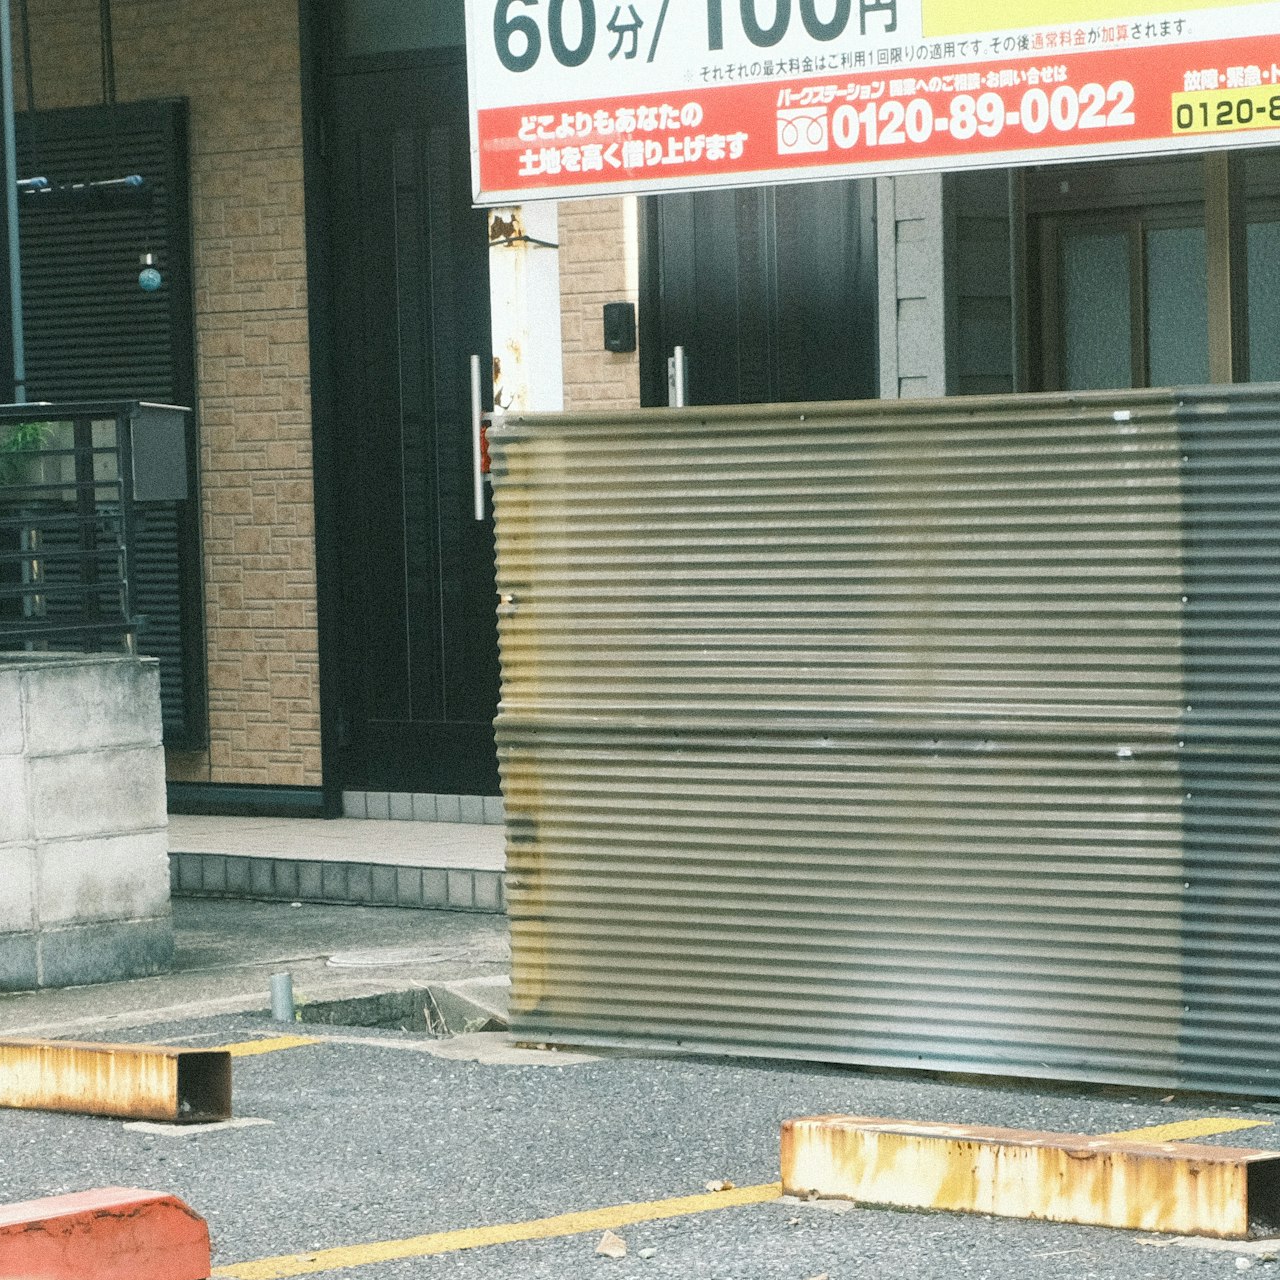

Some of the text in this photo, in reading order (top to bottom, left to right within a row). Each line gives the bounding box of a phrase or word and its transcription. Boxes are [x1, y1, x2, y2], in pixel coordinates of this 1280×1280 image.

[777, 81, 886, 107] パークステーション
[832, 80, 1135, 149] 0120-89-0022
[518, 102, 703, 141] どこよりもあなたの
[518, 131, 749, 176] 土地を高く借り上げます
